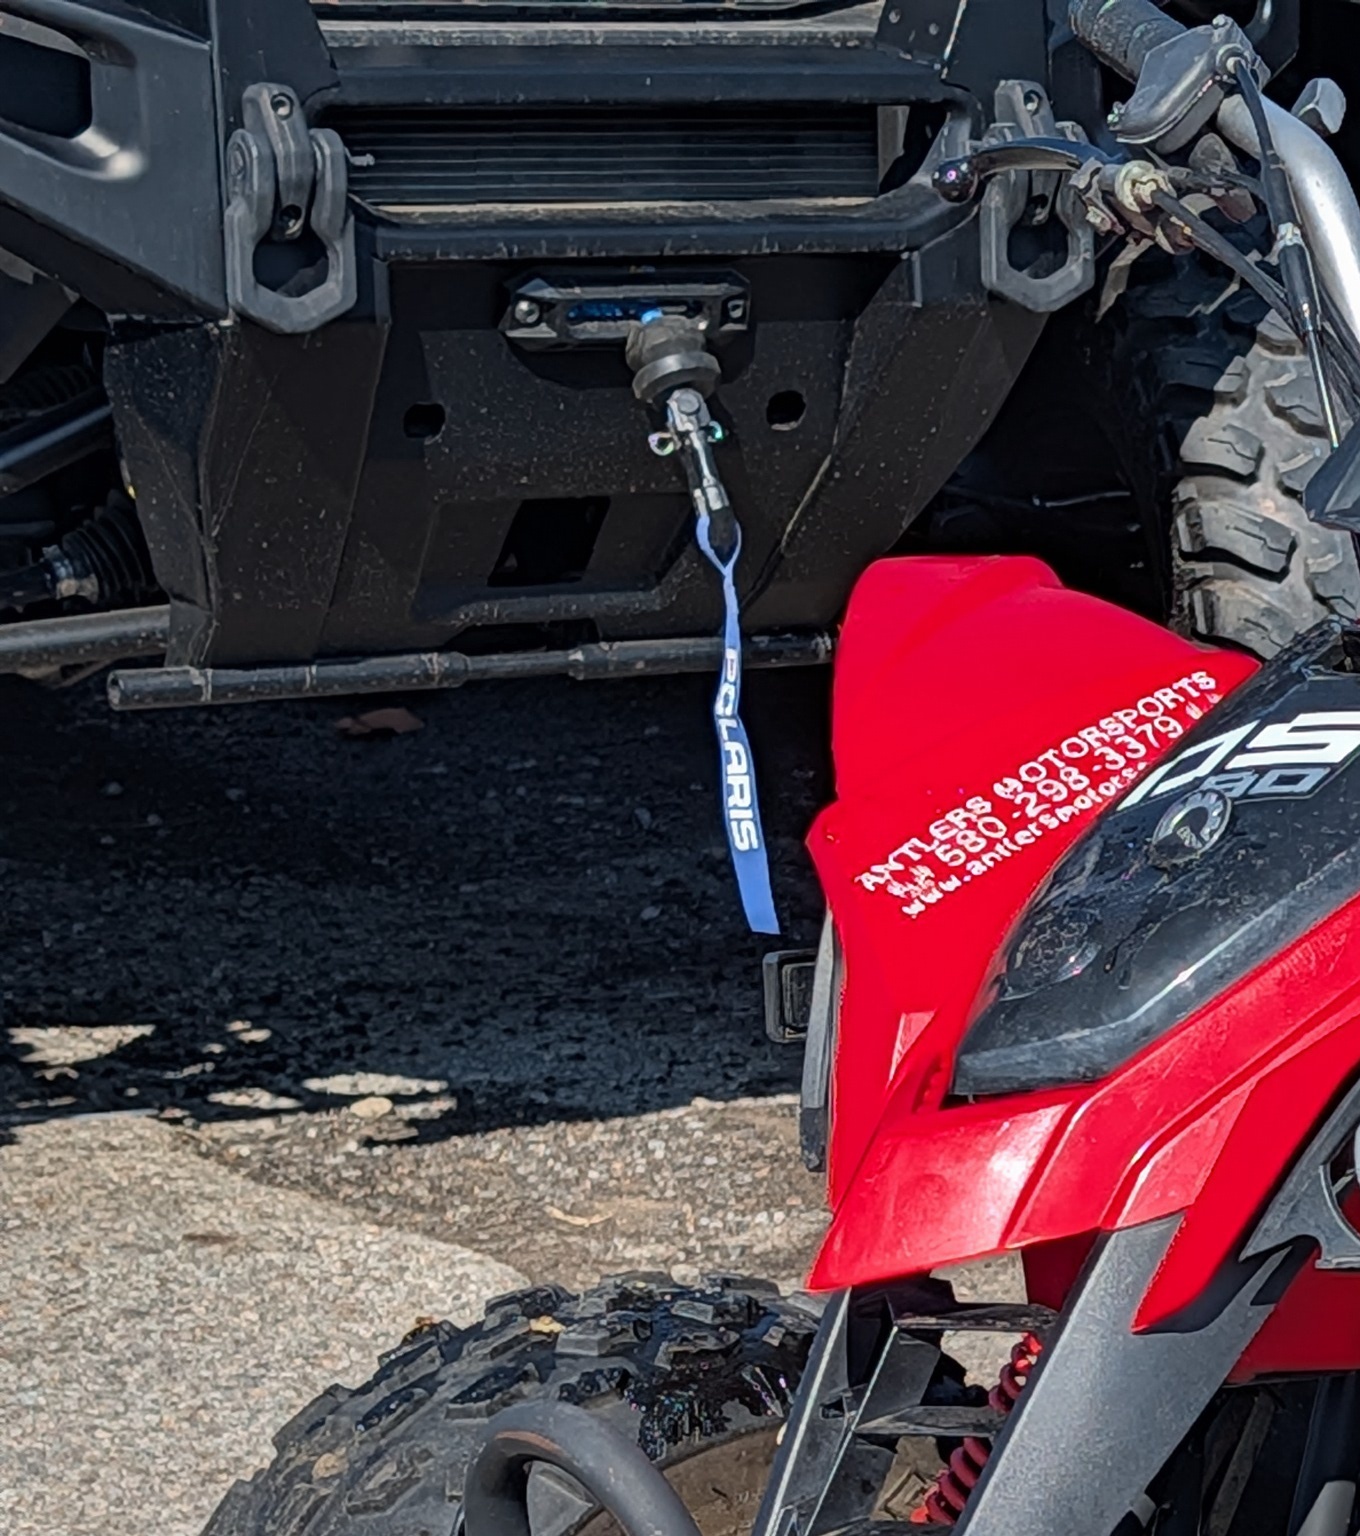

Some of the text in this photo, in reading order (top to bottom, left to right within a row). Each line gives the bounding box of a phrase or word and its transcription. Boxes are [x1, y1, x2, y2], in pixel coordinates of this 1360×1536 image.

[713, 648, 759, 853] POLARIS
[855, 671, 1217, 891] ANTLERS MOTORSPORTS
